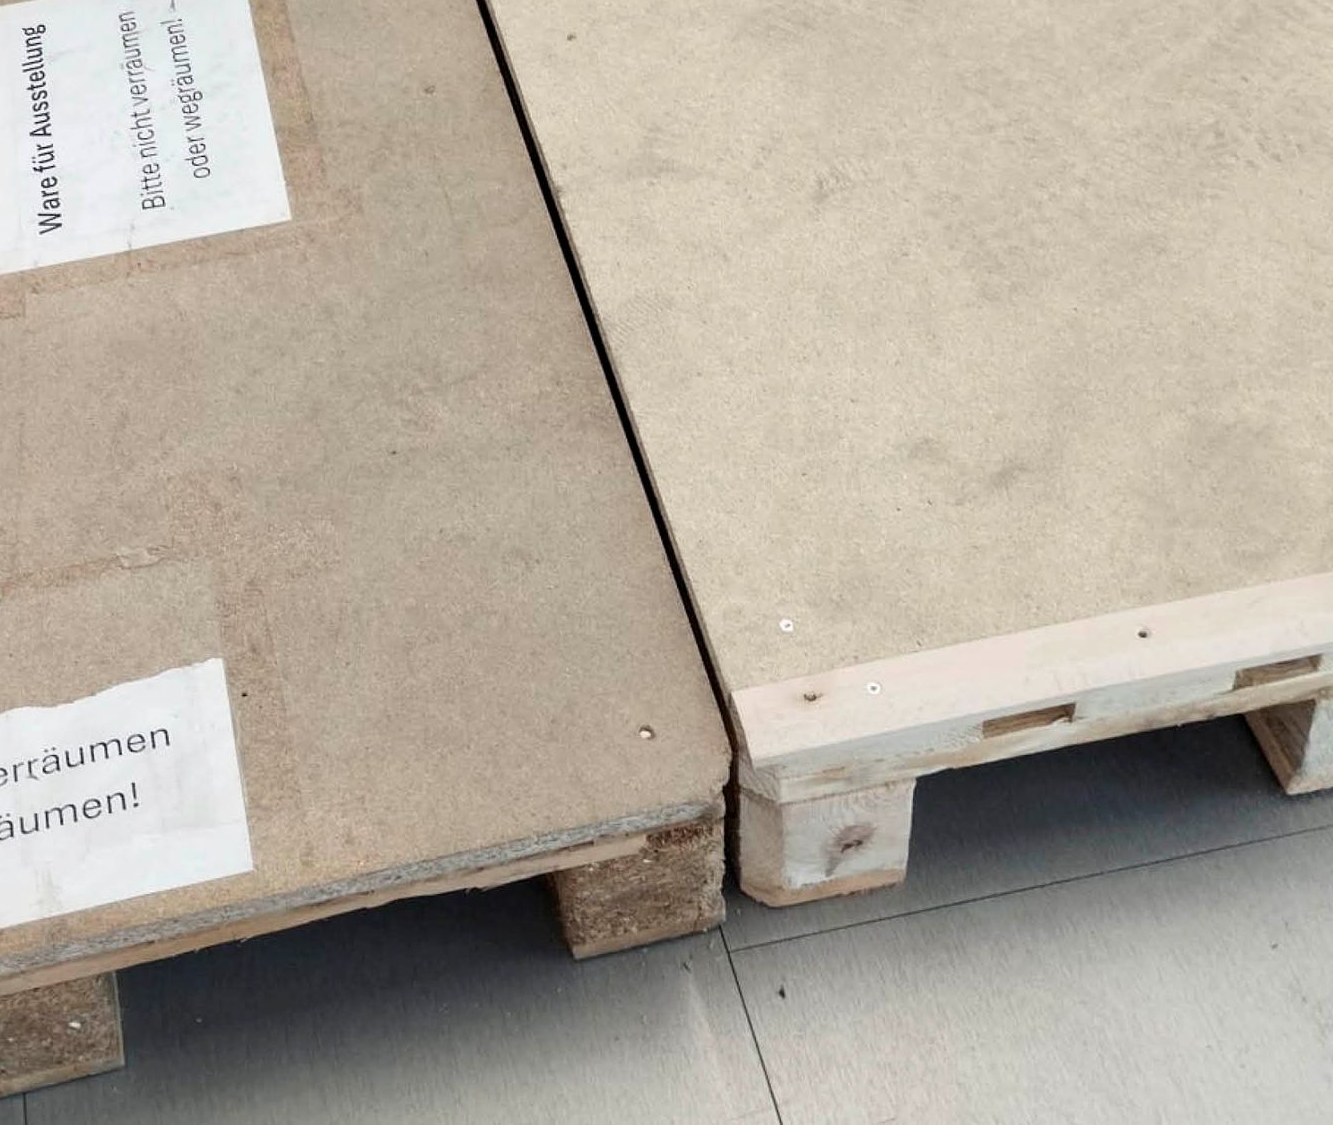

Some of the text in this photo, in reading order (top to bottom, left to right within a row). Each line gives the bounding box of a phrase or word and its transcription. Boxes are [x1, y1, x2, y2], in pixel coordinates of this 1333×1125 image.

[21, 23, 63, 235] Ware für Ausstellung
[118, 10, 166, 211] Bitte nicht verräumen
[159, 18, 211, 179] oder wegräumen!
